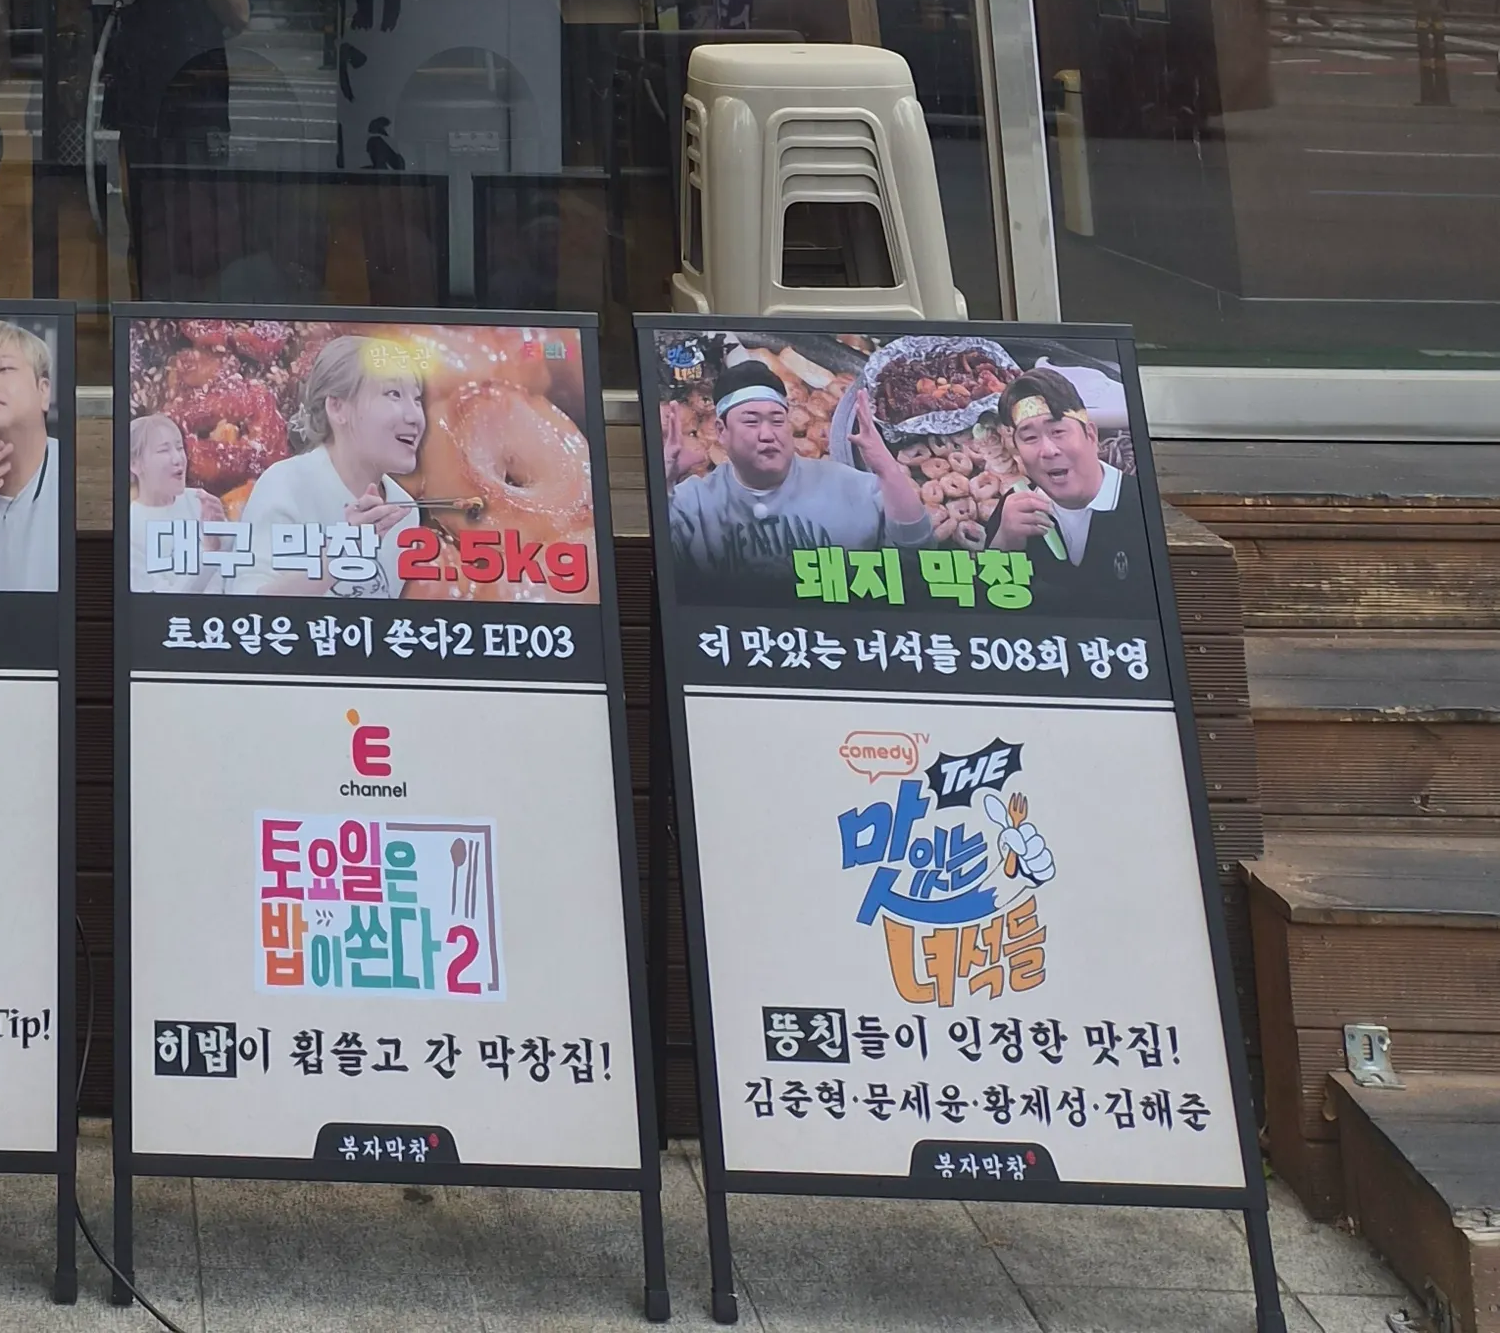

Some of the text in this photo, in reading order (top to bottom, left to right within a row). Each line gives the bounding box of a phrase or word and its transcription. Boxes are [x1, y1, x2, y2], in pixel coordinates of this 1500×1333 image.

[368, 344, 433, 370] 맑눈광
[145, 518, 590, 594] 대구 막창 2.5kg
[793, 545, 1034, 610] 돼지 막창
[162, 613, 575, 660] 토요일은 밥이 쏜다2 EP.03
[698, 624, 1151, 681] 더 맛있는 녀석들 508회 방영
[839, 732, 931, 765] comedy TV
[941, 746, 1010, 796] THE
[339, 780, 407, 799] channel
[260, 818, 418, 904] 토요일은
[882, 894, 1048, 1008] 녀석들
[155, 1024, 612, 1084] 히밥이 휩쓸고 간 막창집!
[764, 1011, 1182, 1069] 뚱친들이 인정한 맛집!
[337, 1134, 429, 1164] 봉자막창
[933, 1151, 1027, 1182] 봉자막창
